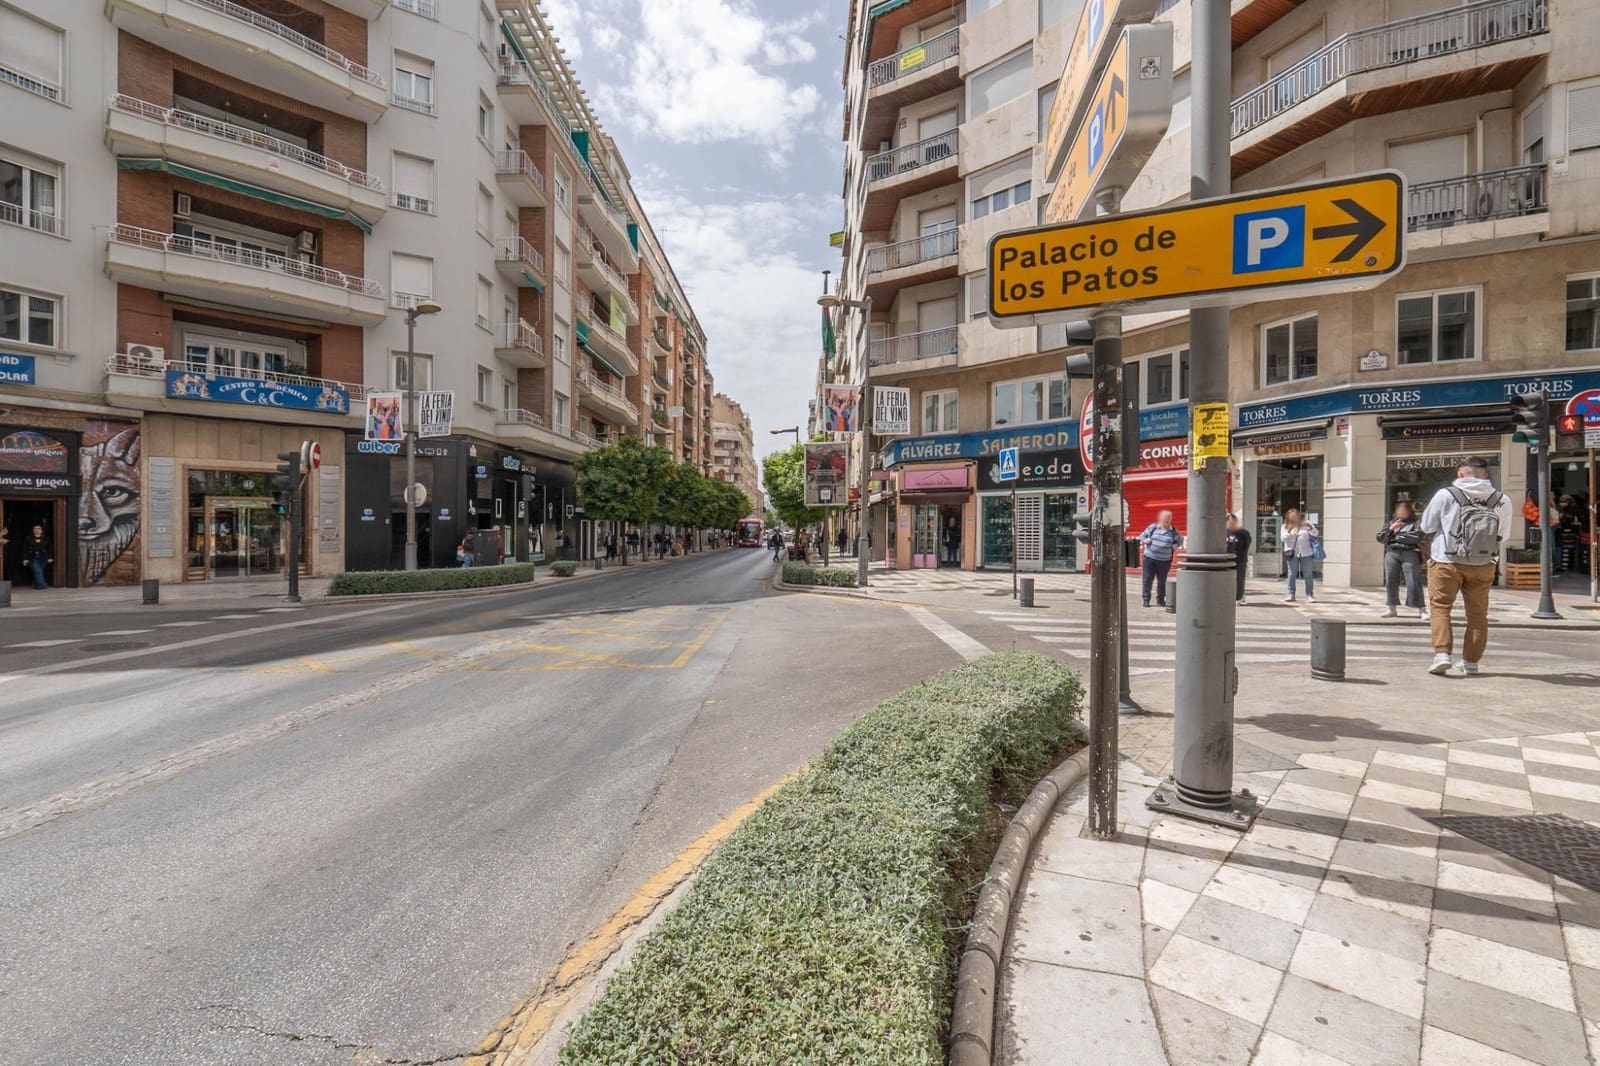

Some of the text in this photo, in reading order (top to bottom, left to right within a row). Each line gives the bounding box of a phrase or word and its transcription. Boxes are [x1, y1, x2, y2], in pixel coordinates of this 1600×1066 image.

[1090, 114, 1100, 167] P
[1000, 226, 1176, 272] Palacio de
[1247, 216, 1289, 266] P
[1000, 265, 1159, 302] los Patos
[219, 381, 309, 402] CENTRO ACDÉMICO
[1504, 379, 1573, 396] TORRES
[421, 393, 452, 409] LA FERIA
[876, 390, 908, 407] LA FERIA
[1359, 390, 1421, 405] TORRES
[875, 406, 908, 422] DEL VINO
[1242, 405, 1287, 422] TORRES
[358, 441, 400, 453] wiber
[901, 442, 960, 459] ALVAREZ
[979, 432, 1069, 455] SALMERON
[1140, 444, 1189, 460] CORNE
[1253, 442, 1312, 456] Cristina
